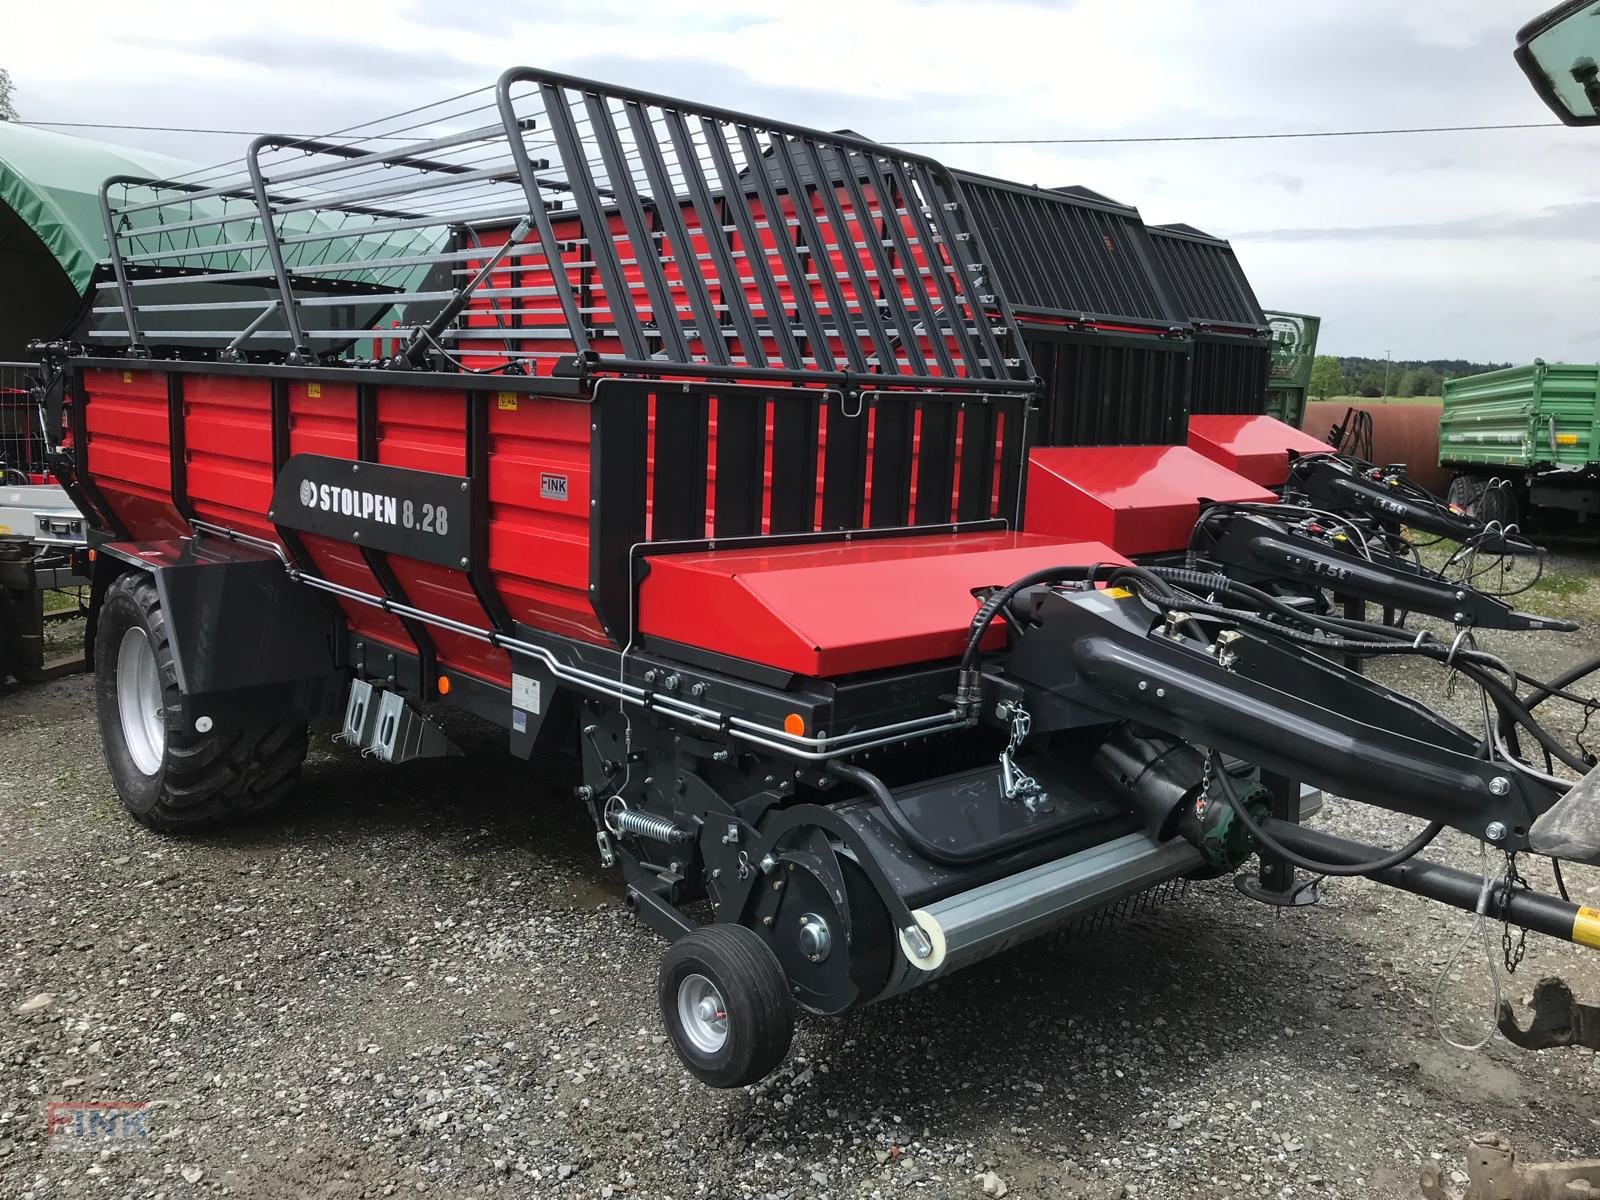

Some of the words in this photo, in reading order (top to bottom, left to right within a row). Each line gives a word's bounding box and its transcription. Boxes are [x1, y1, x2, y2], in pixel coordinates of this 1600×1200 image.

[541, 474, 566, 492] FINK
[320, 484, 397, 525] STOLPEN
[402, 500, 448, 536] 8.28
